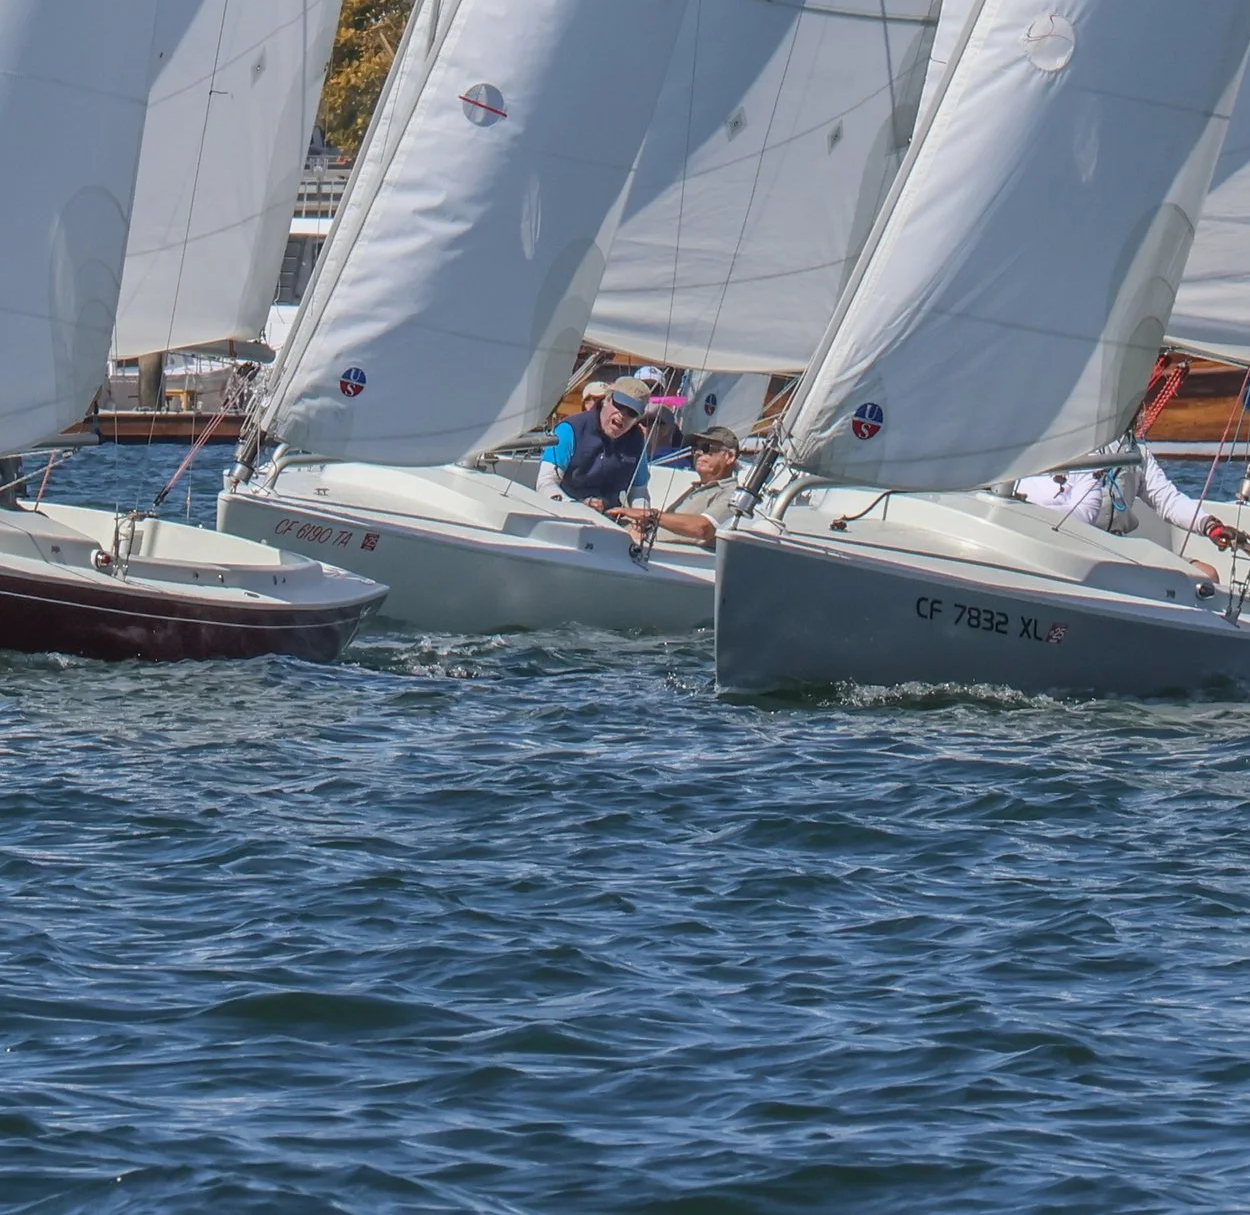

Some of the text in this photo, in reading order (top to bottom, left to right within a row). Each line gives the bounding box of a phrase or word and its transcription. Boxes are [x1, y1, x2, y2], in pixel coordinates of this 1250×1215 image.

[274, 518, 354, 548] CF 6190 TA
[916, 597, 1043, 642] CF 7832 XL
